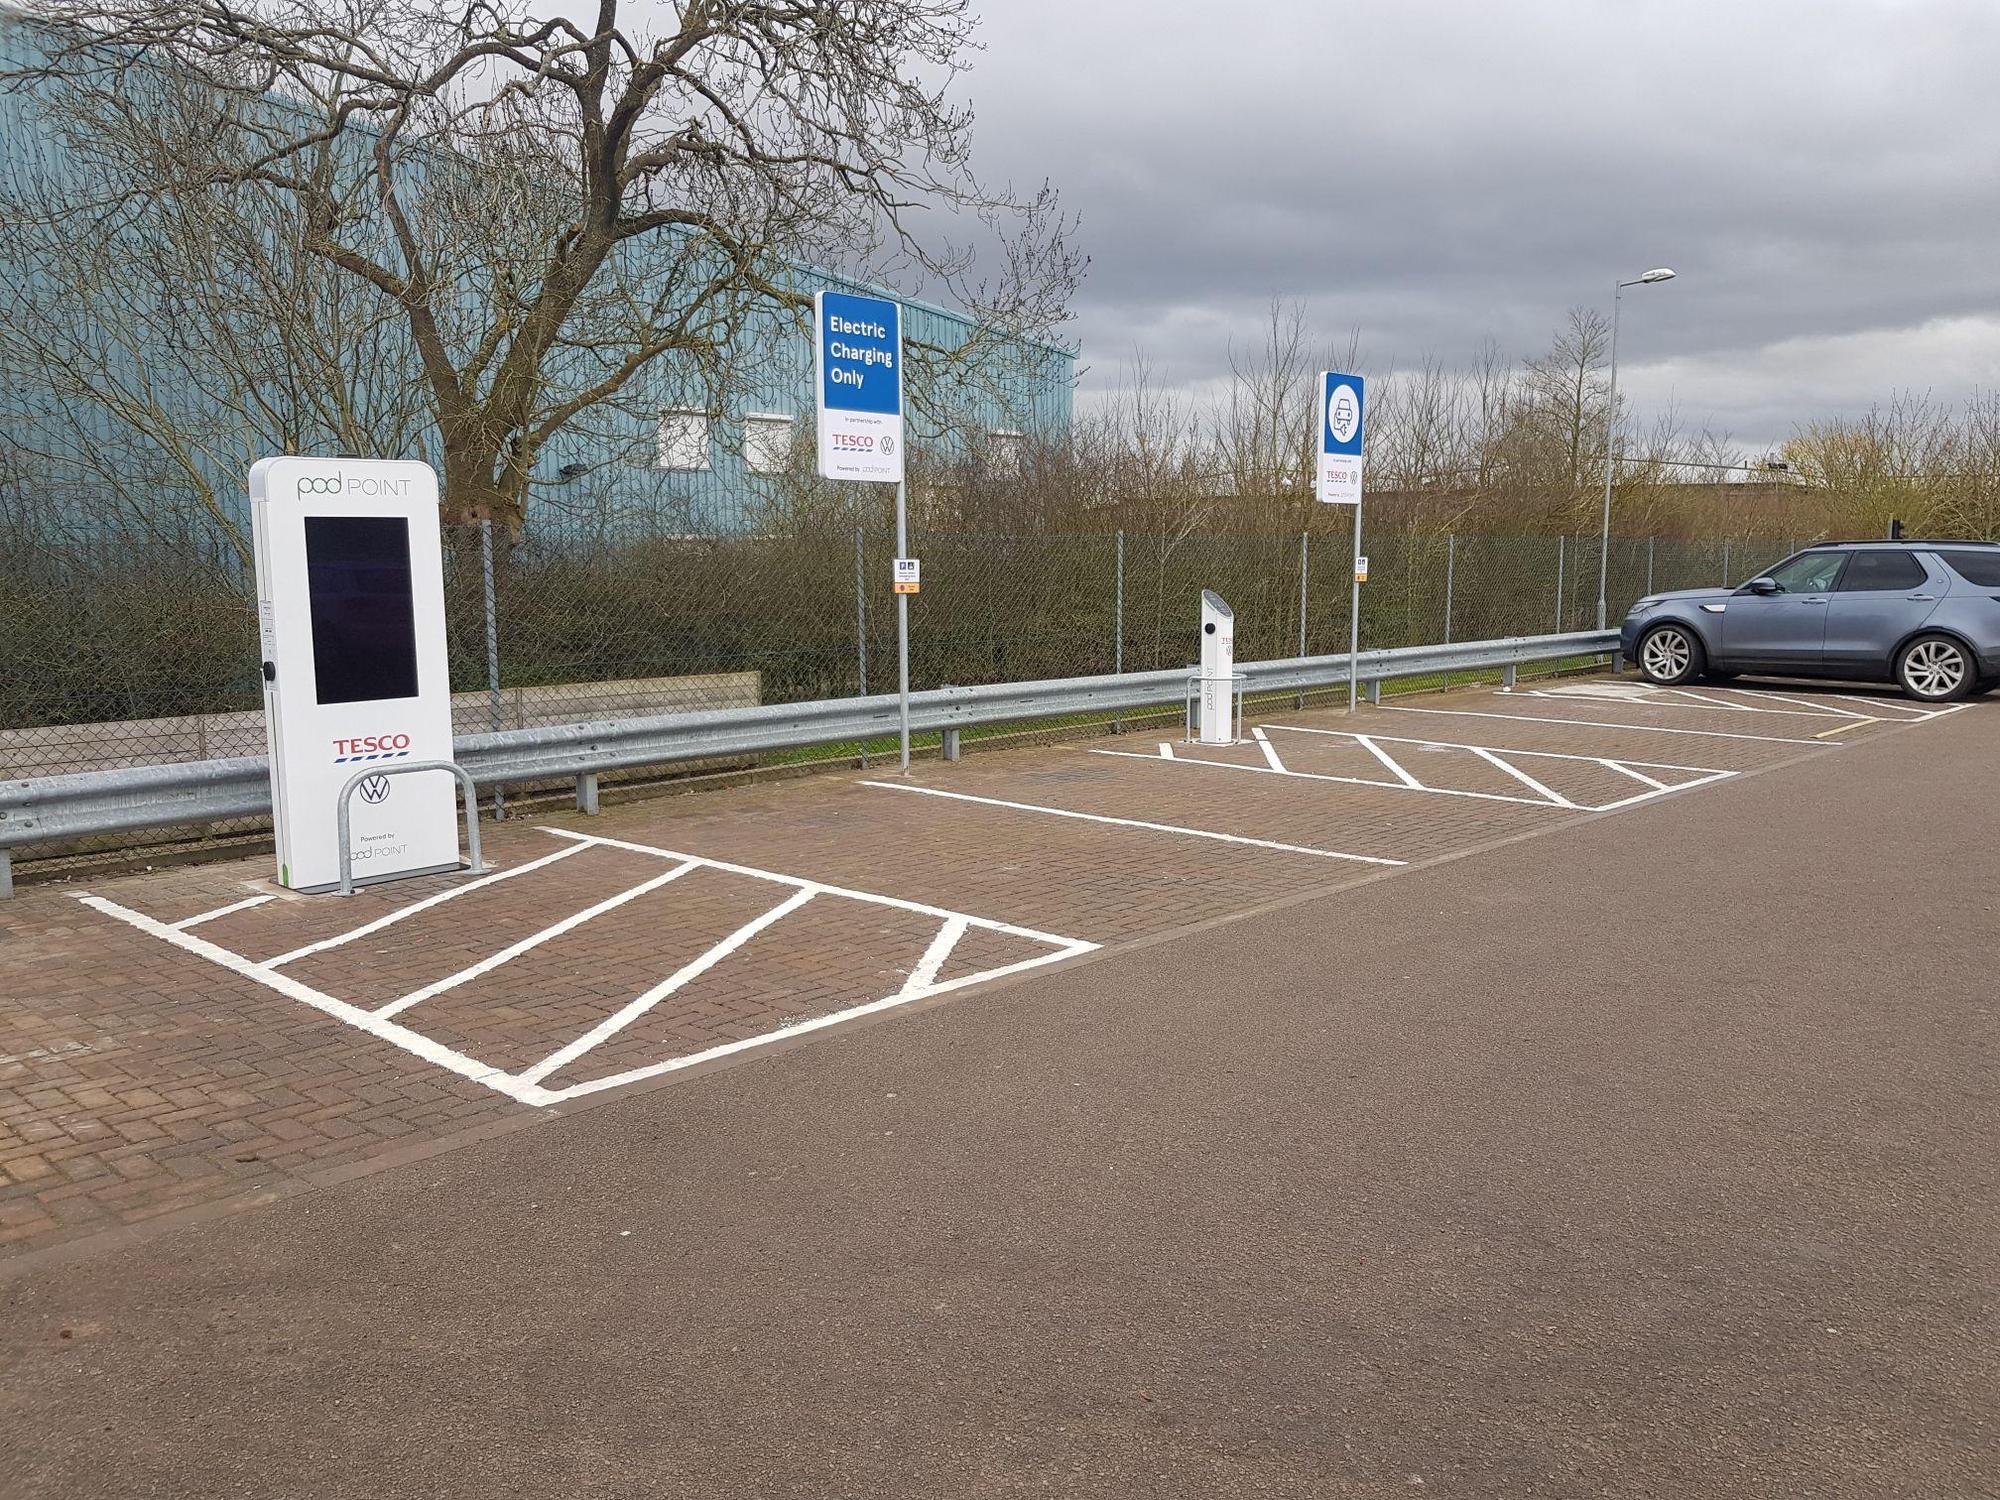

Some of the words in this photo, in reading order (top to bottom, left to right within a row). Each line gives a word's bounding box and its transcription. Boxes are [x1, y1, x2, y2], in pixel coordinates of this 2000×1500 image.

[830, 315, 886, 339] Electric
[830, 342, 893, 368] Charging
[831, 367, 864, 390] Only
[832, 434, 874, 448] TESCO
[1326, 470, 1348, 480] TESCO
[297, 470, 342, 502] pod
[347, 479, 411, 496] POINT
[333, 734, 411, 755] TESCO
[360, 834, 387, 843] Powered
[374, 844, 408, 858] POINT
